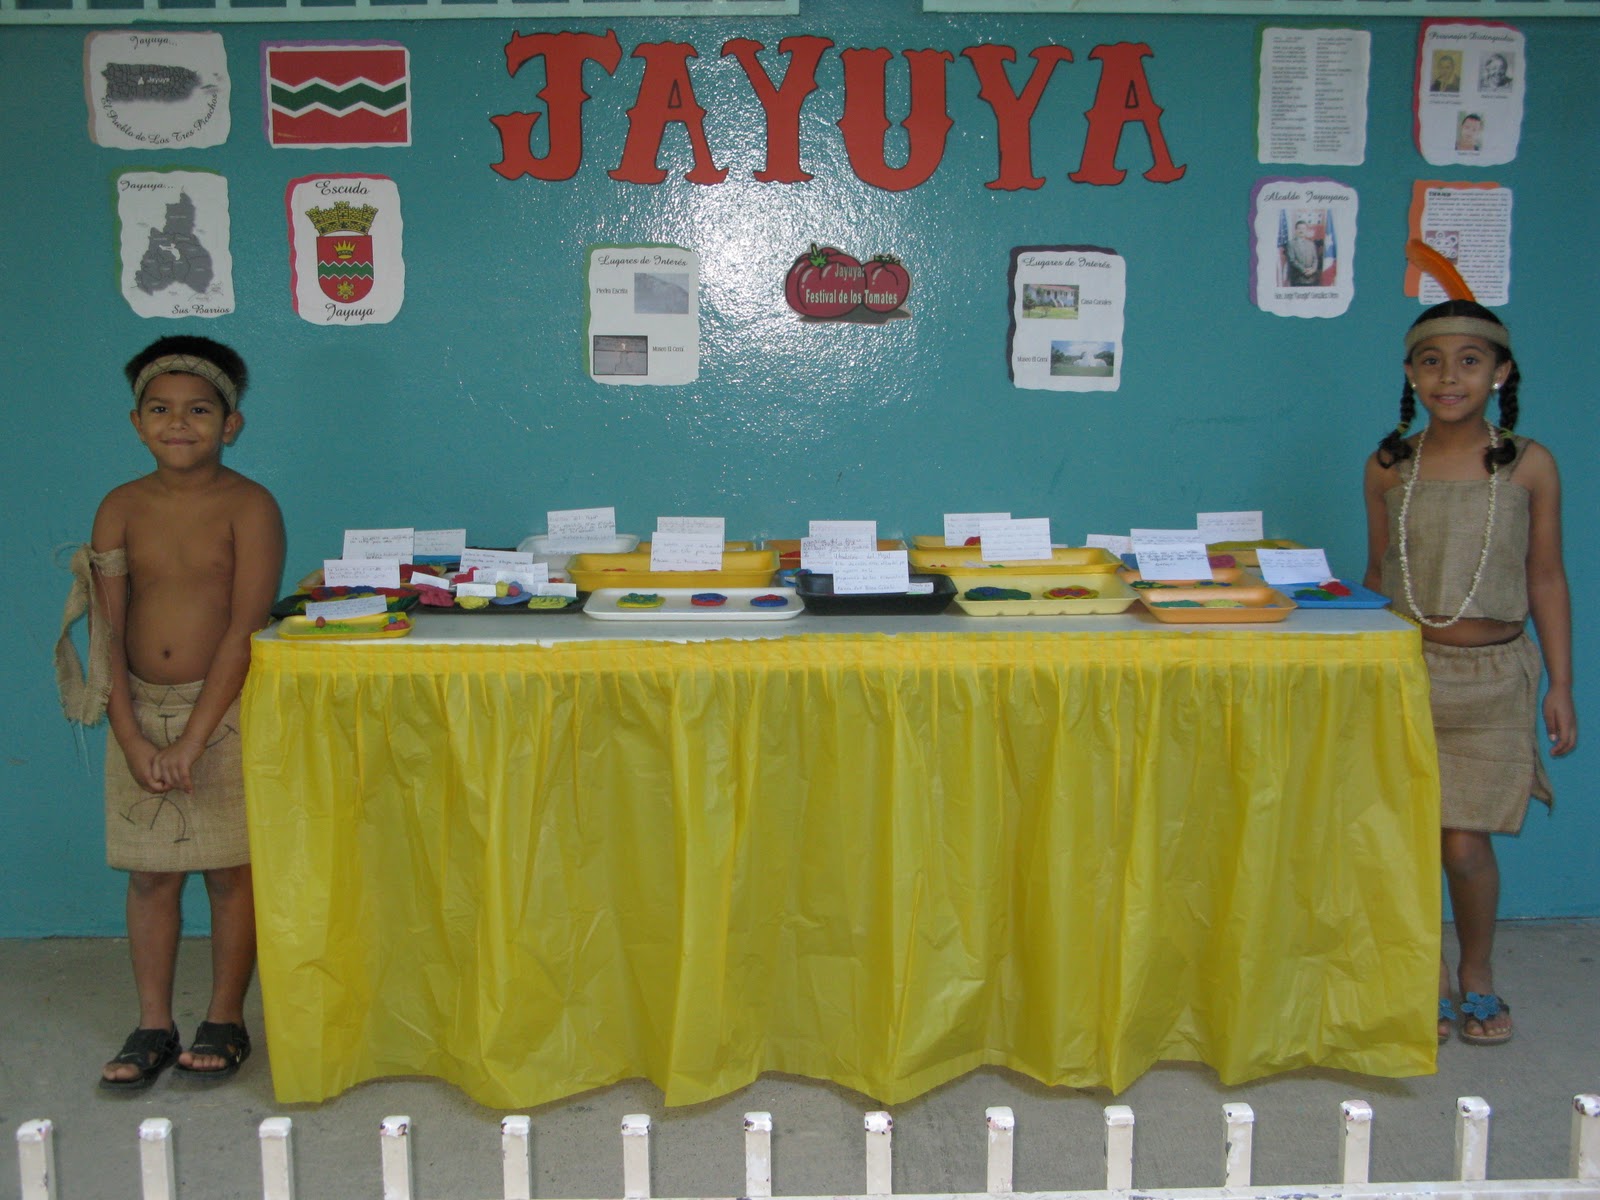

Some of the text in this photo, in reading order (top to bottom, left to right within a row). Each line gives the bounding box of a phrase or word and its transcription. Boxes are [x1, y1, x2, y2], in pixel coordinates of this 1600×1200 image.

[146, 76, 170, 85] Jayuya
[489, 29, 1186, 191] JAYUYA
[106, 110, 133, 137] Pueblo
[135, 133, 146, 142] de
[147, 134, 170, 144] Los
[171, 129, 195, 142] Tres
[193, 93, 218, 131] Picachos
[315, 180, 370, 196] Escudo
[1264, 190, 1350, 204] Alcalde Jayuyano
[597, 254, 688, 268] Lugares de Interés
[1022, 256, 1111, 269] Lugares de Interés
[805, 289, 898, 305] Festival de los Tomates
[1080, 298, 1112, 306] Casa Canales
[171, 304, 232, 315] Sus Barrios
[324, 302, 375, 321] Jayuya
[652, 345, 667, 353] Museo
